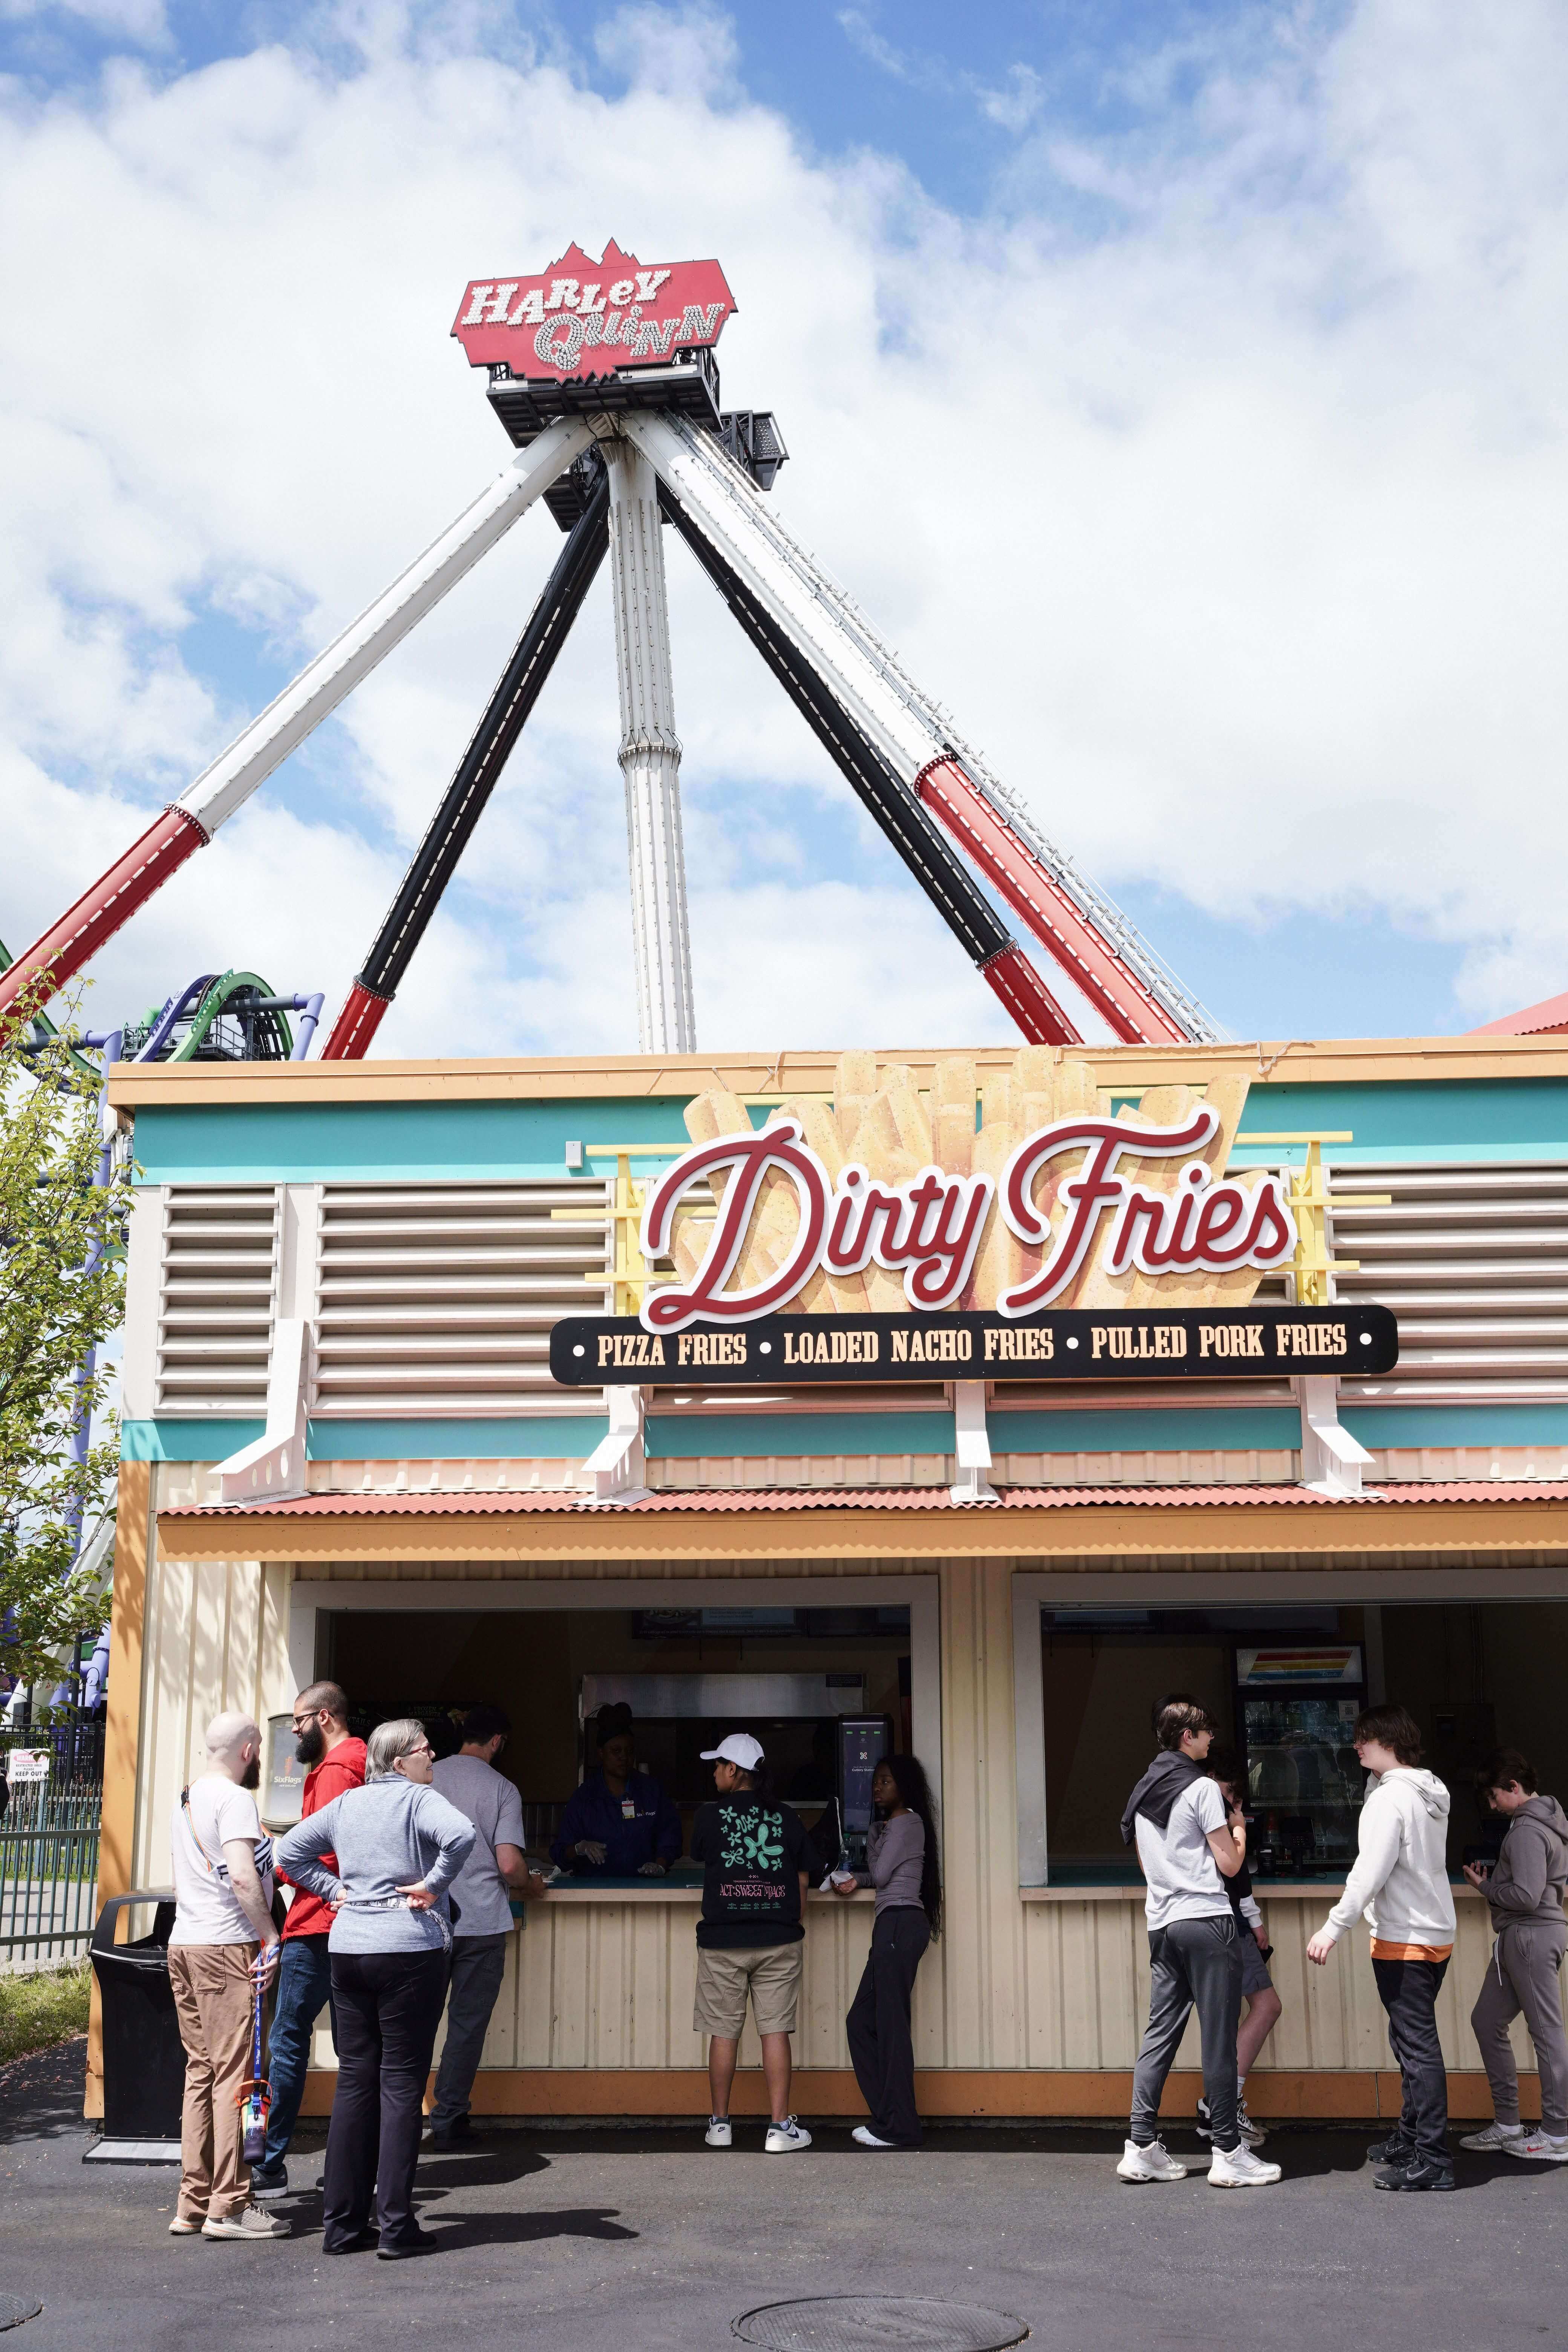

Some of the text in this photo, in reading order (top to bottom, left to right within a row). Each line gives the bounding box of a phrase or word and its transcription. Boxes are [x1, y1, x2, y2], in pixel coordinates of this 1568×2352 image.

[648, 1113, 1289, 1325] Dirty Fries
[598, 1323, 1347, 1366] PIZZA FRIES LOADED NACHO FRIES PULLED PORK FRIES
[347, 1716, 371, 1727] KTAILS
